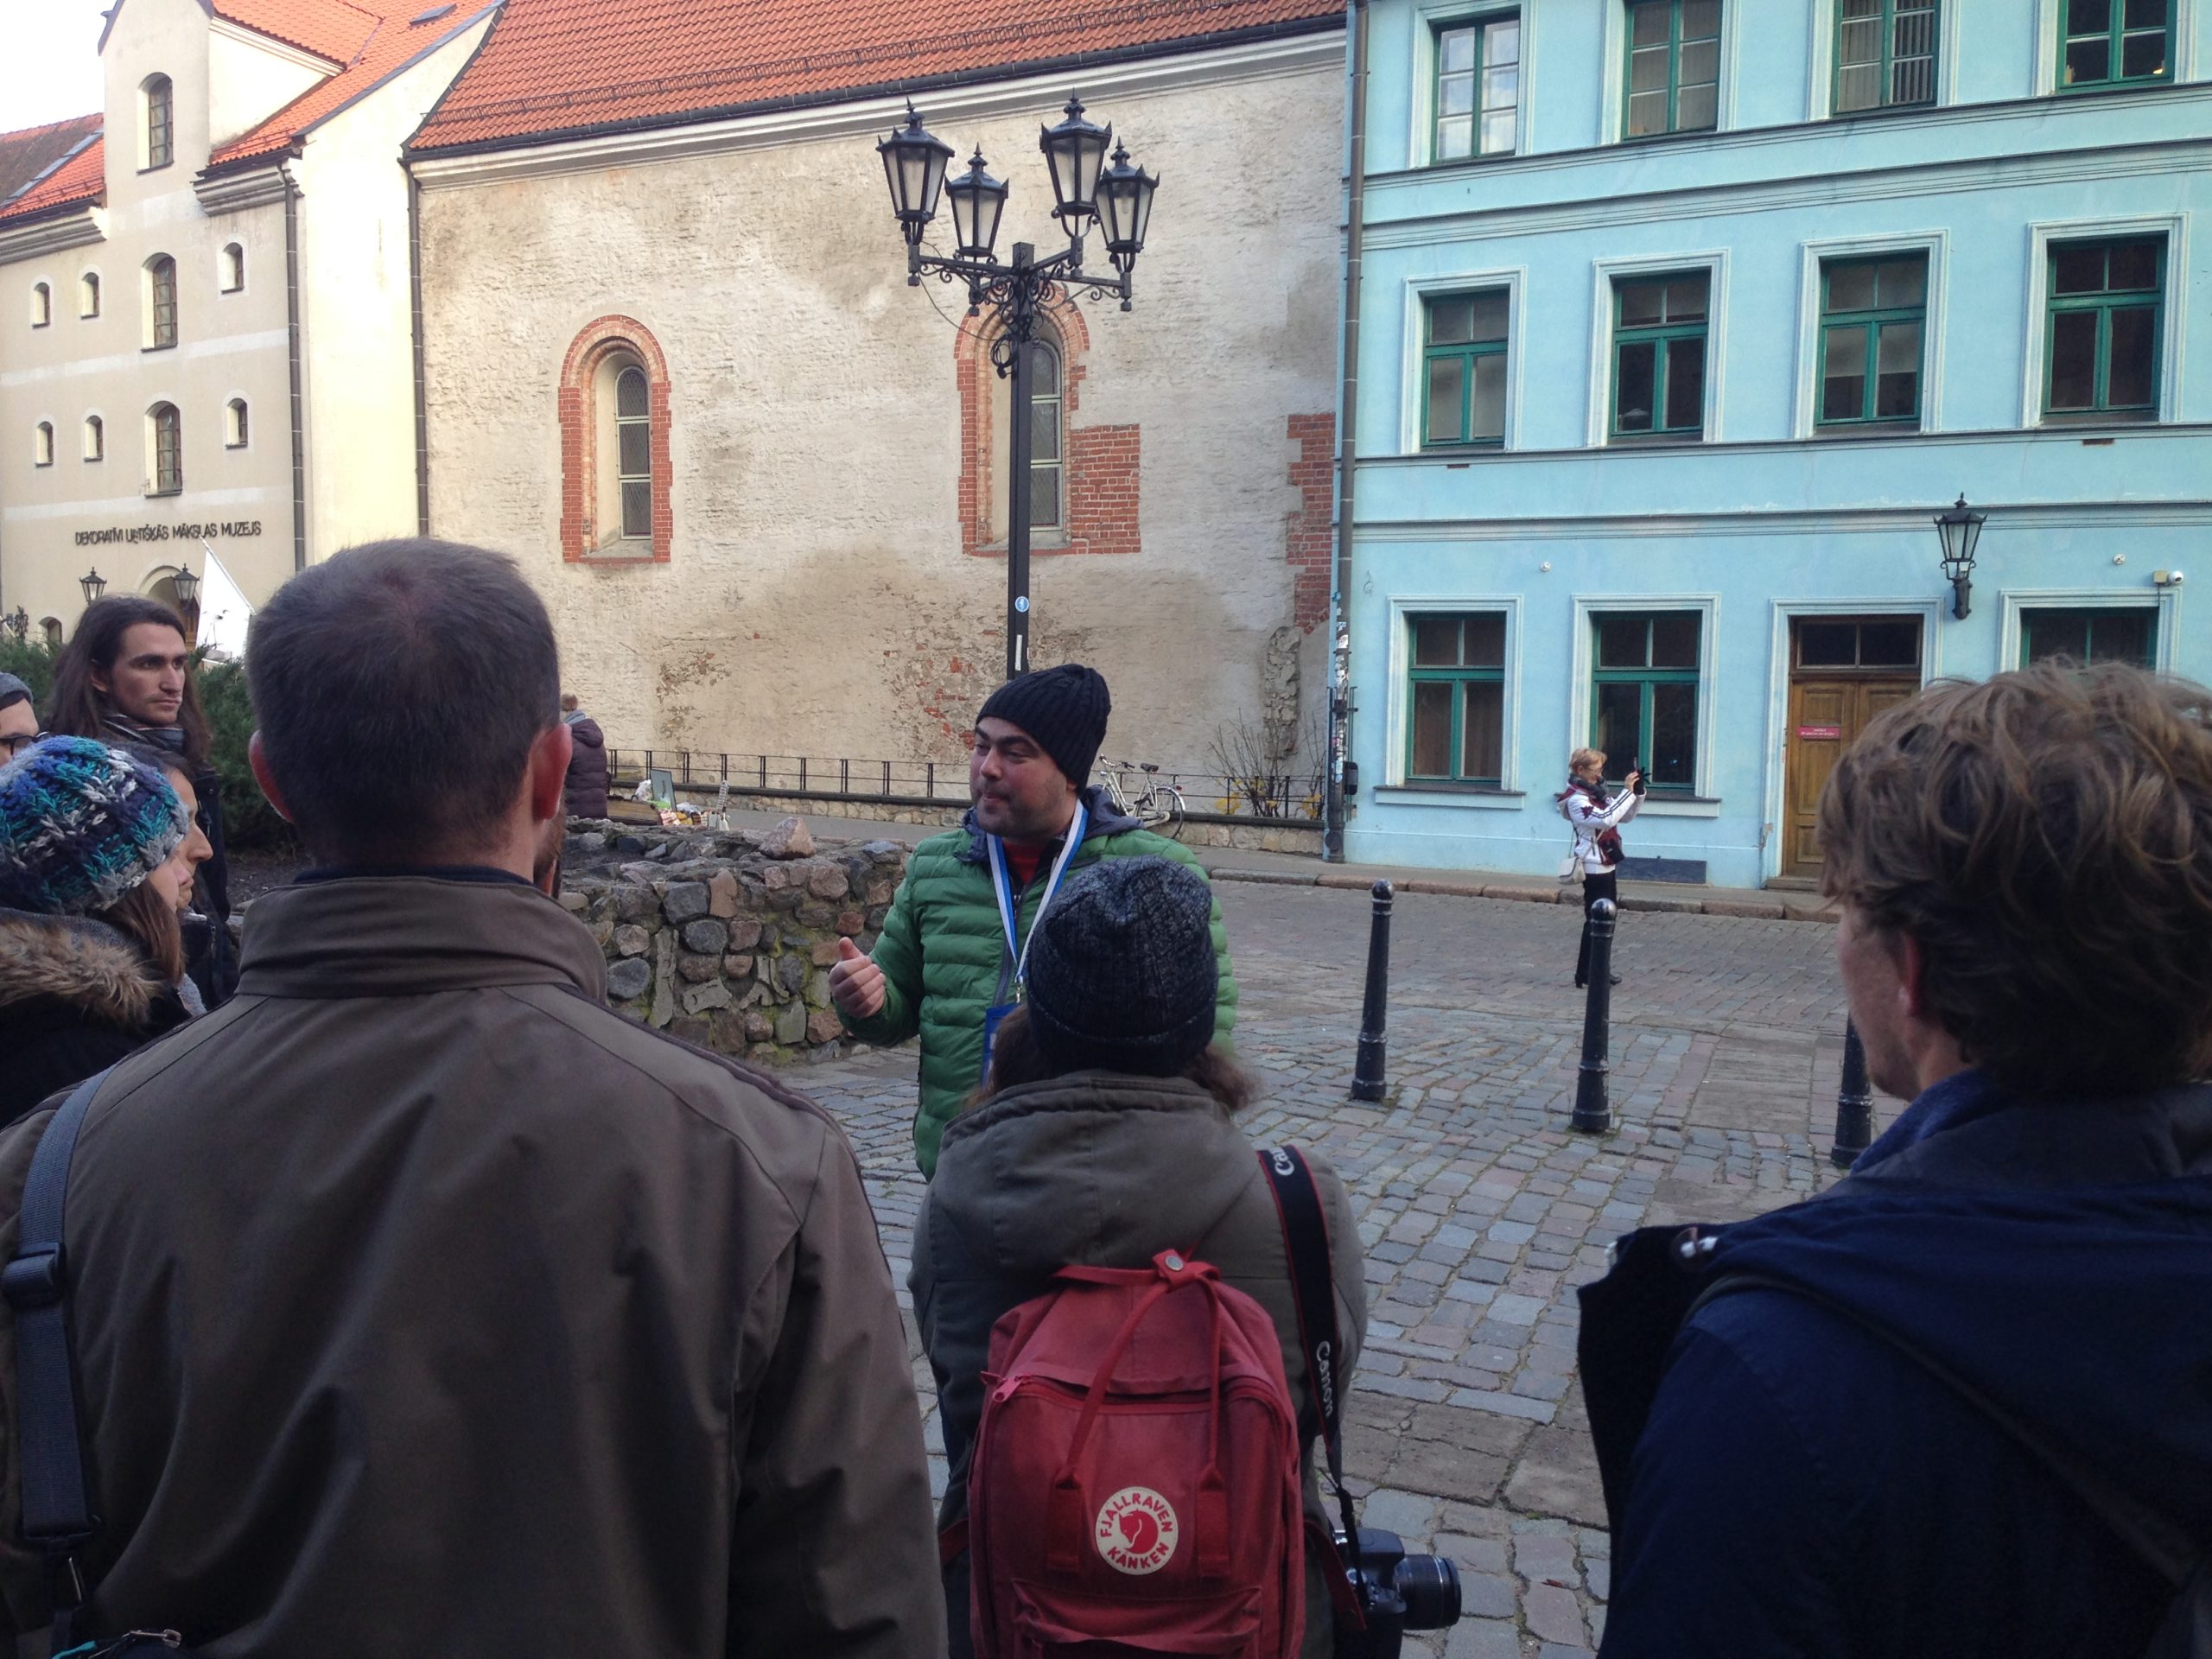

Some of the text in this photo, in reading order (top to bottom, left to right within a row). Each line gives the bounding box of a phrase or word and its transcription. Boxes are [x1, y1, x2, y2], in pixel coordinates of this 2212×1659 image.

[173, 522, 218, 539] MĀKSLAS
[221, 520, 262, 537] MUZEJS
[1316, 1340, 1333, 1418] Canon
